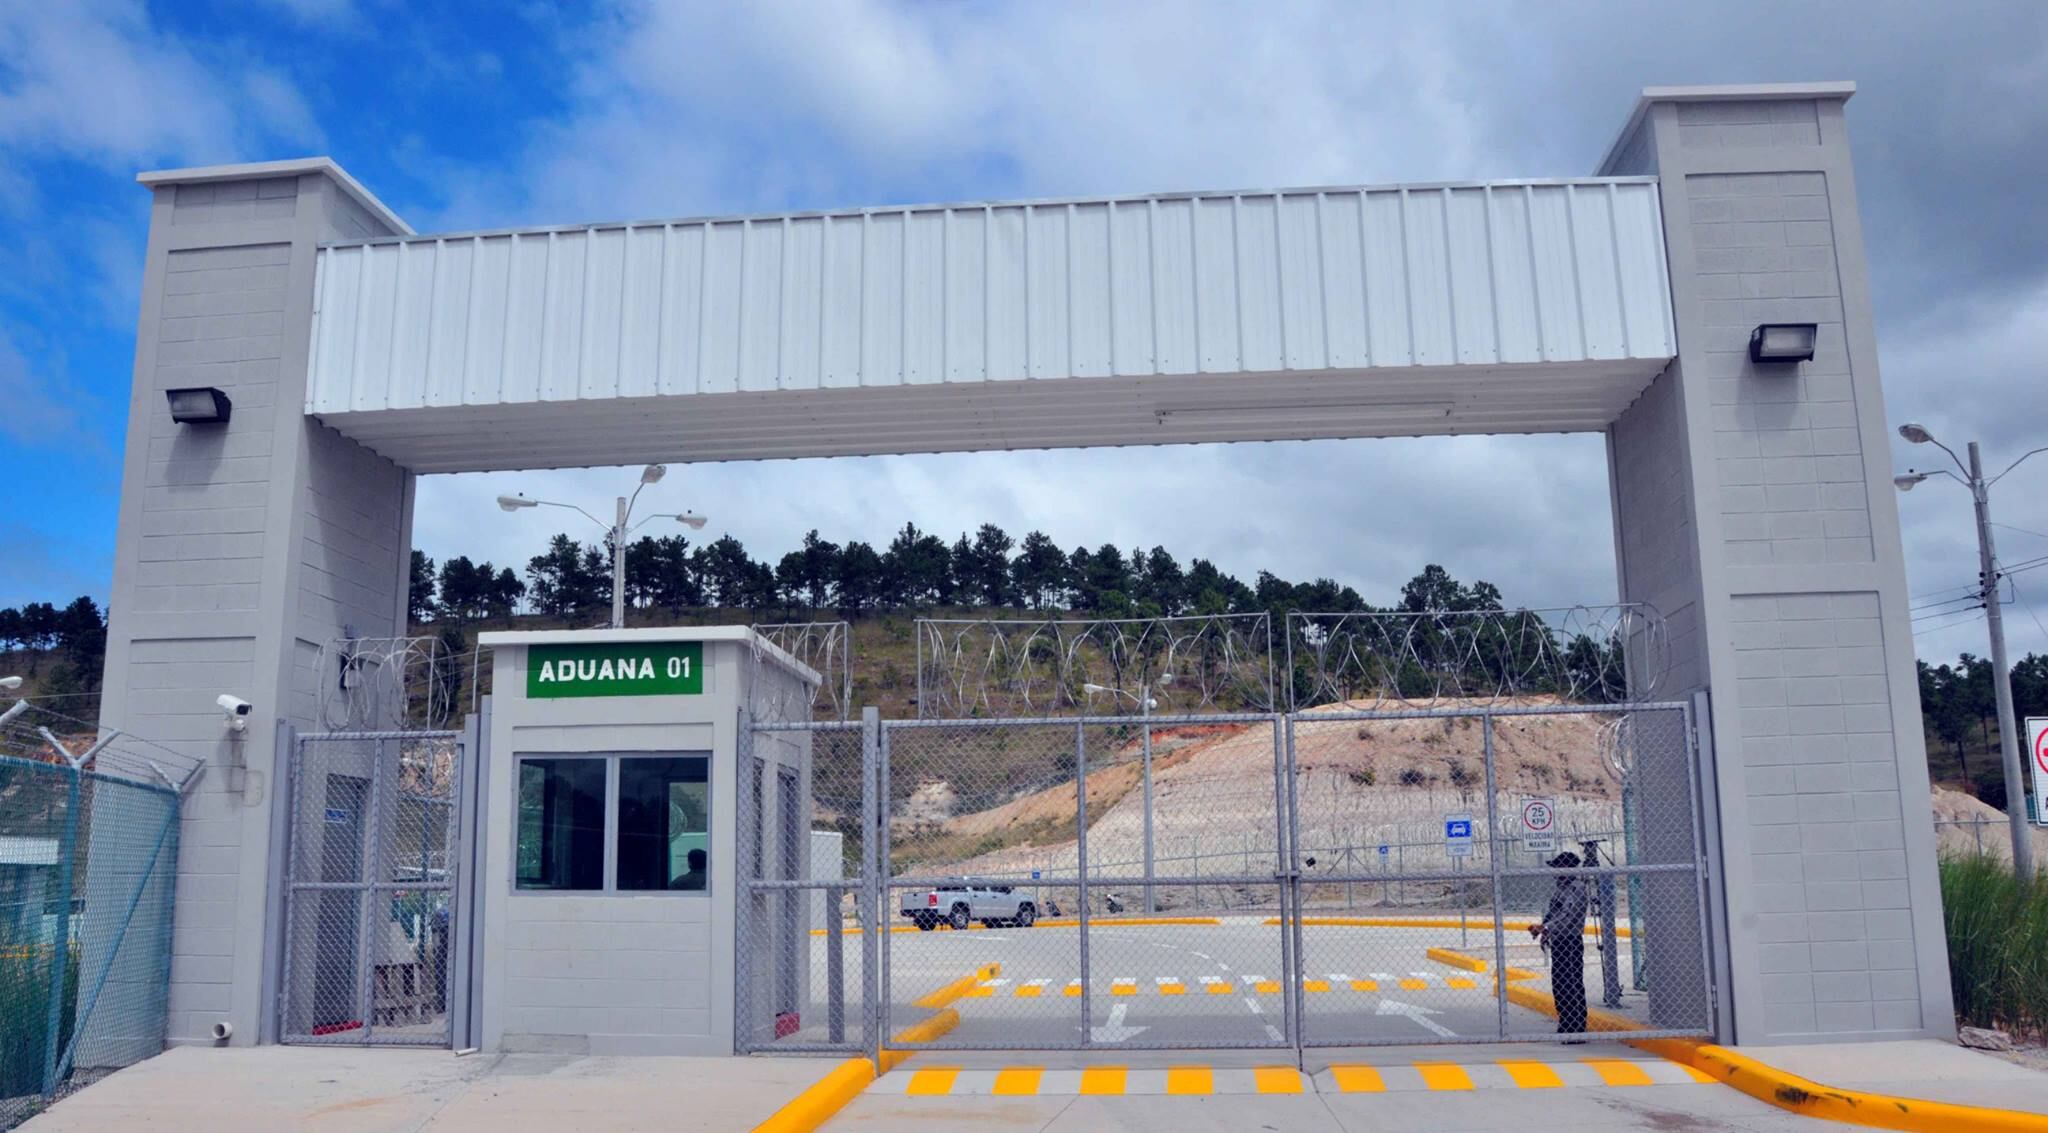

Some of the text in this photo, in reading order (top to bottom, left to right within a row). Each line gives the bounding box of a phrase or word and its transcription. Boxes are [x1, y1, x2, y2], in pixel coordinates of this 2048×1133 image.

[538, 656, 690, 682] ADUANA 01
[1531, 807, 1545, 818] 25
